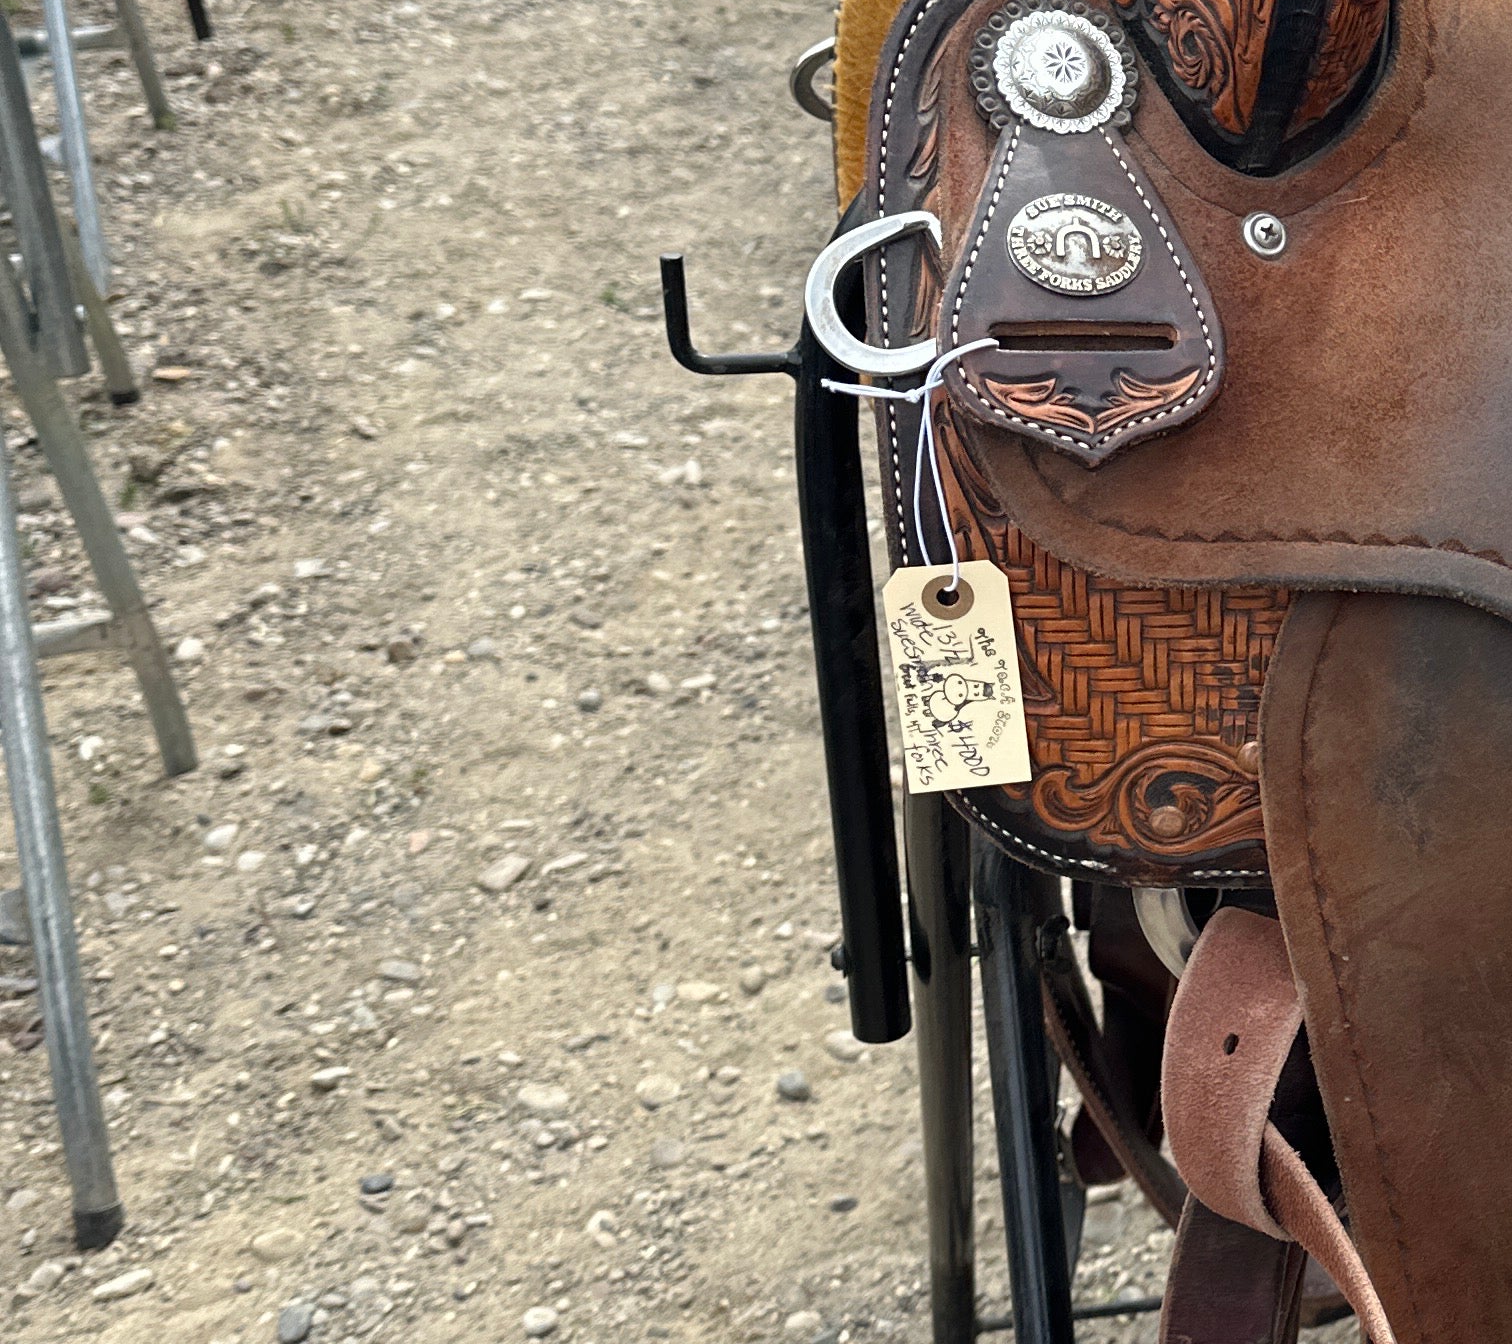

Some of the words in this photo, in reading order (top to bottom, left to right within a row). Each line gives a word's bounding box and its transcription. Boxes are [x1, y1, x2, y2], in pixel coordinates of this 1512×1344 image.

[1025, 196, 1062, 218] SUE
[1063, 194, 1123, 223] SMITH
[1010, 225, 1042, 276] THREE
[1038, 269, 1093, 291] FORKS
[1094, 233, 1143, 291] SADDLERY
